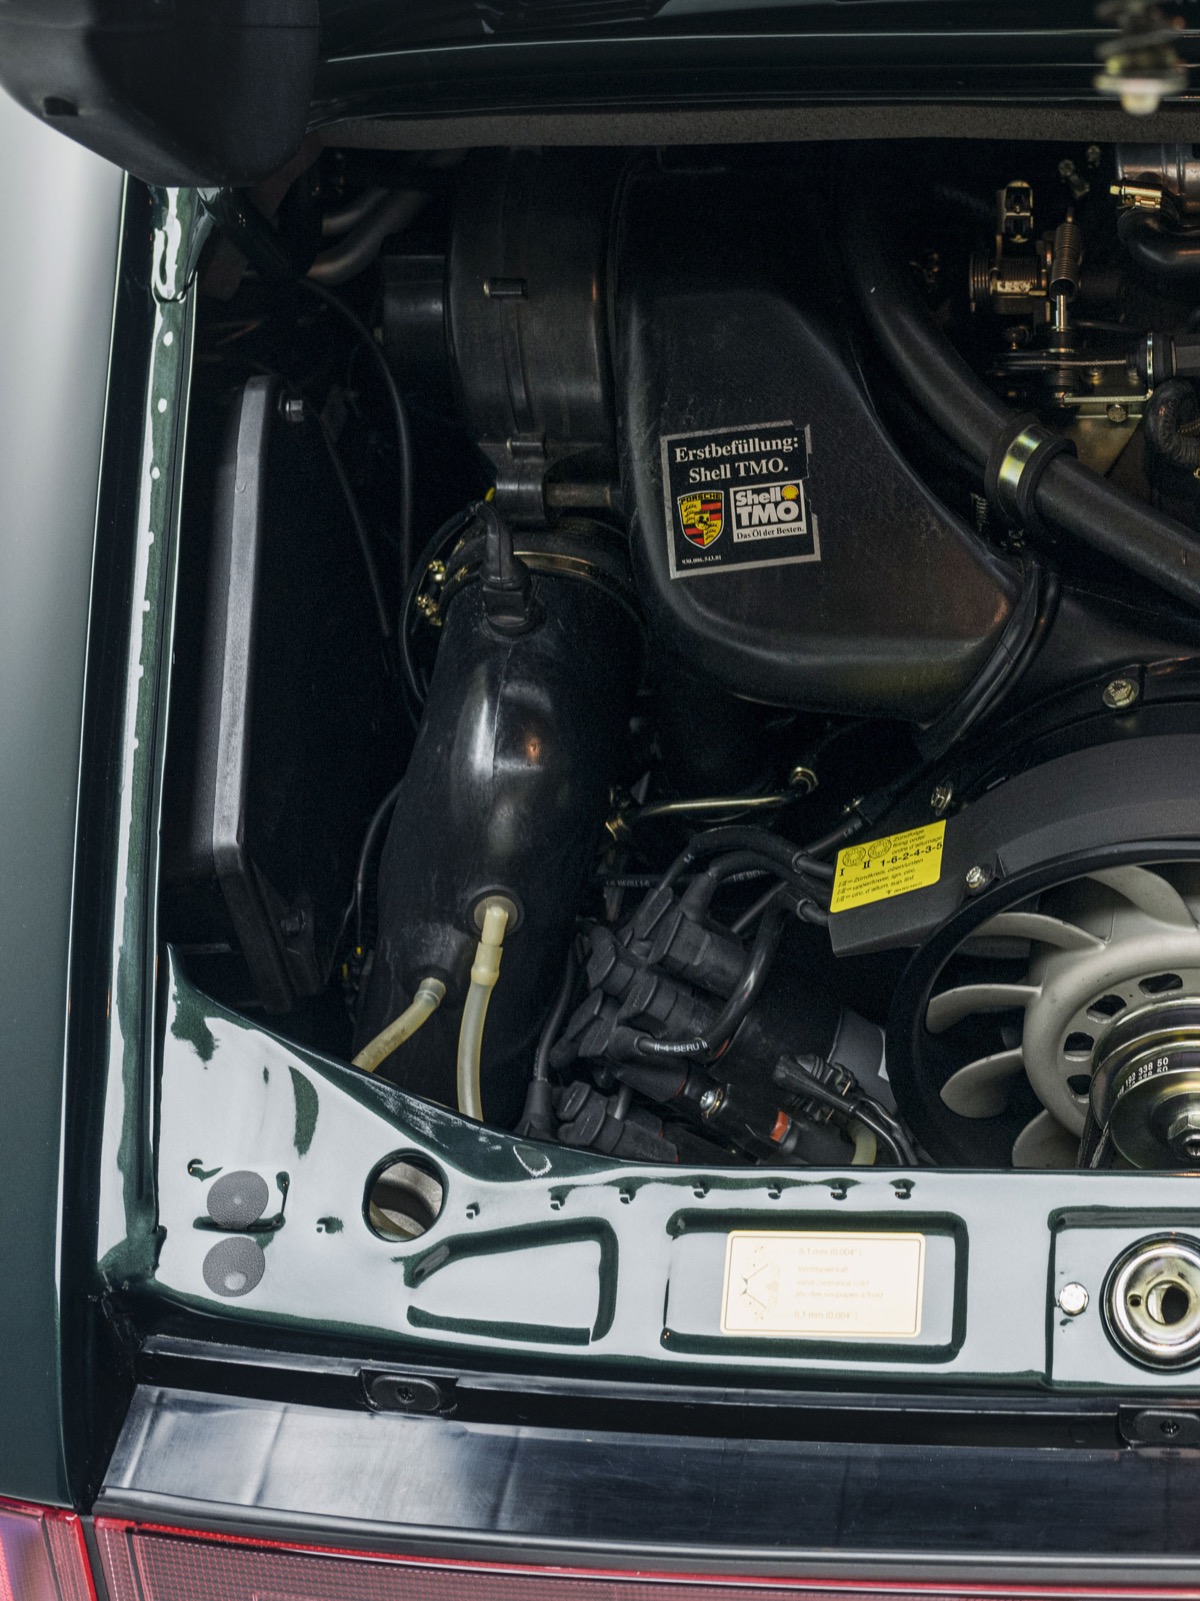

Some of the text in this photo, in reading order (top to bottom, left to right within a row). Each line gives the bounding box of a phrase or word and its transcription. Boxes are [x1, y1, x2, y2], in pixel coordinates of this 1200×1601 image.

[674, 437, 799, 463] Erstbefüllung:
[689, 457, 789, 484] Shell TMO.
[679, 492, 723, 505] PORSCHE
[735, 486, 782, 506] Shell
[736, 500, 800, 527] TMO
[736, 526, 805, 540] Das Öl der Besten.
[881, 842, 943, 868] 1-6-2-4-3-5
[673, 1042, 700, 1053] BERU
[1157, 1057, 1169, 1067] 50
